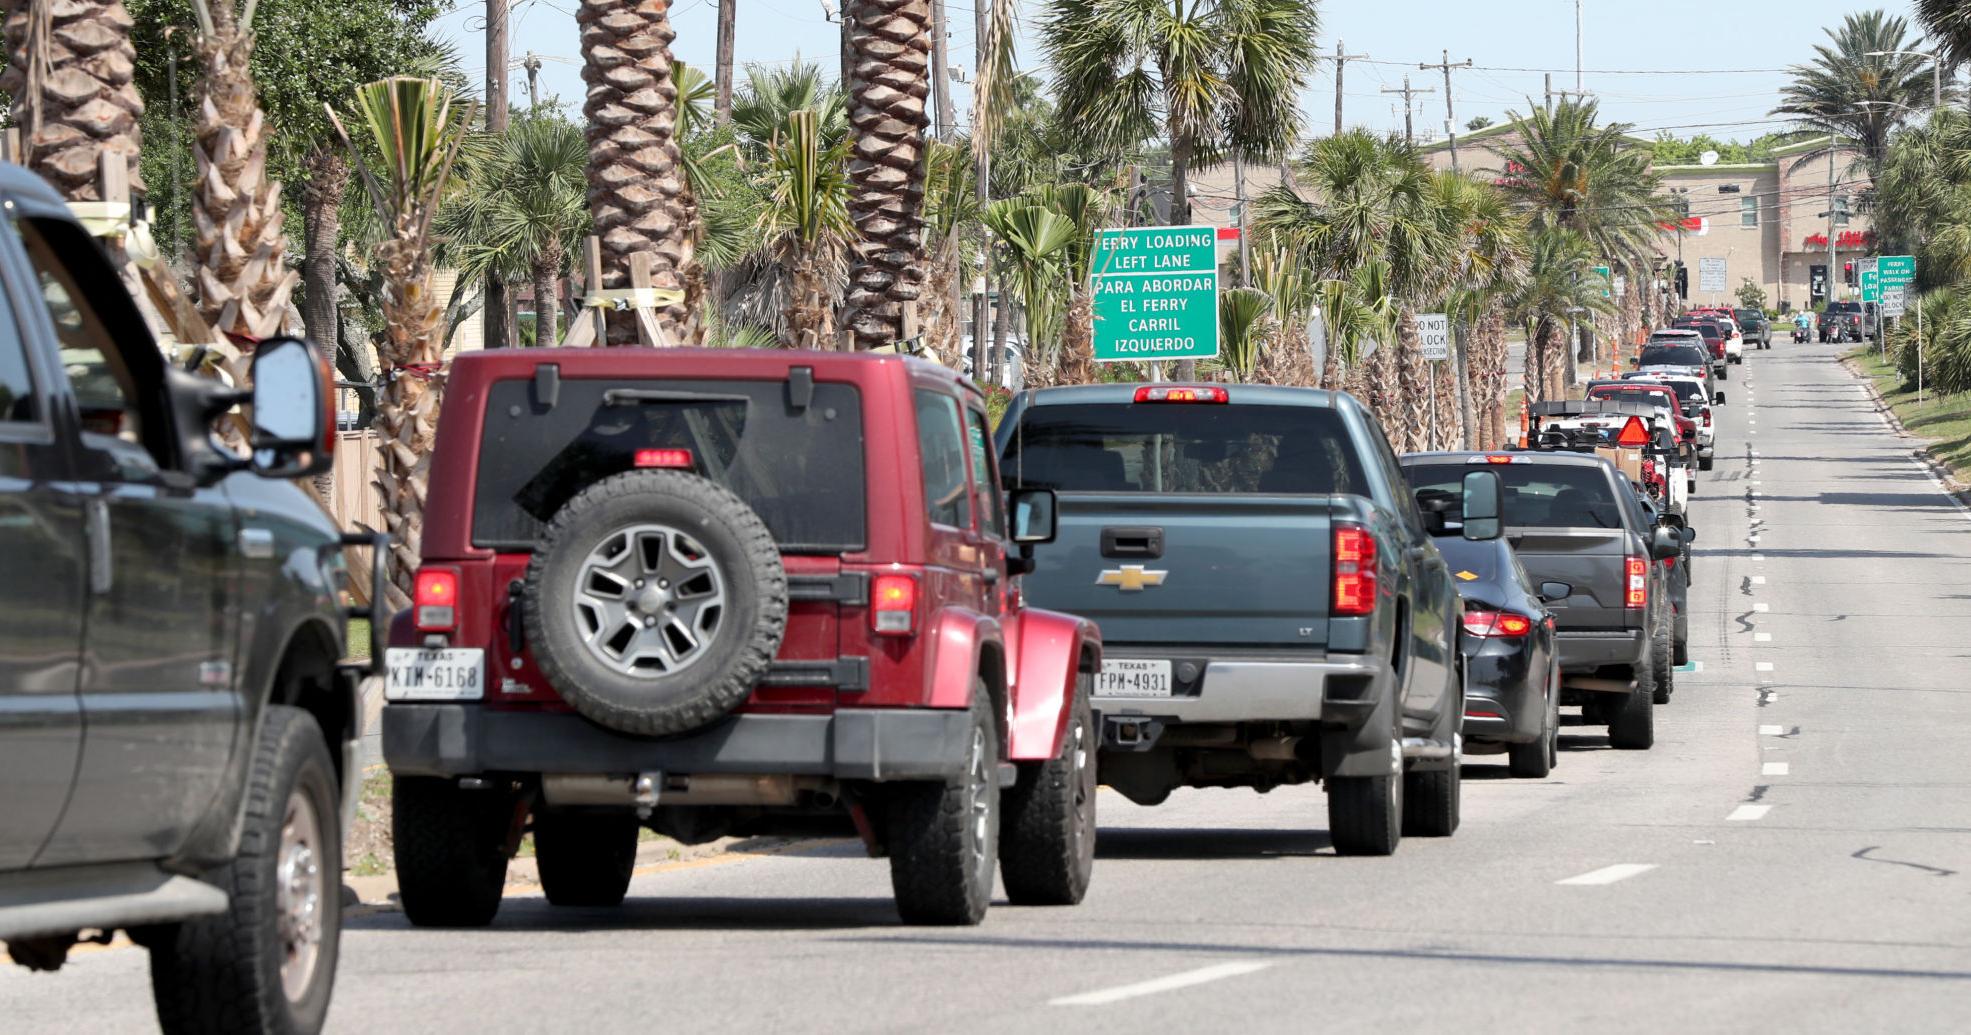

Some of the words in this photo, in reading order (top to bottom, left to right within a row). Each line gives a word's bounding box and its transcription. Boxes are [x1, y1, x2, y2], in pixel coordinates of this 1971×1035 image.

[1094, 236, 1138, 251] ERRY
[1146, 234, 1212, 249] LOADING
[1115, 255, 1147, 269] LEFT
[1154, 254, 1191, 268] LANE
[1095, 280, 1134, 295] PARA
[1142, 278, 1212, 292] ABORDAR
[1121, 300, 1136, 313] EL
[1143, 298, 1188, 312] FERRY
[1128, 318, 1181, 332] CARRIL
[1427, 320, 1445, 331] NOT
[1115, 337, 1195, 352] IZQUIERDO
[1420, 334, 1446, 345] LOCK
[1300, 627, 1312, 636] LT
[418, 652, 453, 661] TEXAS
[1118, 662, 1148, 670] TEXAS
